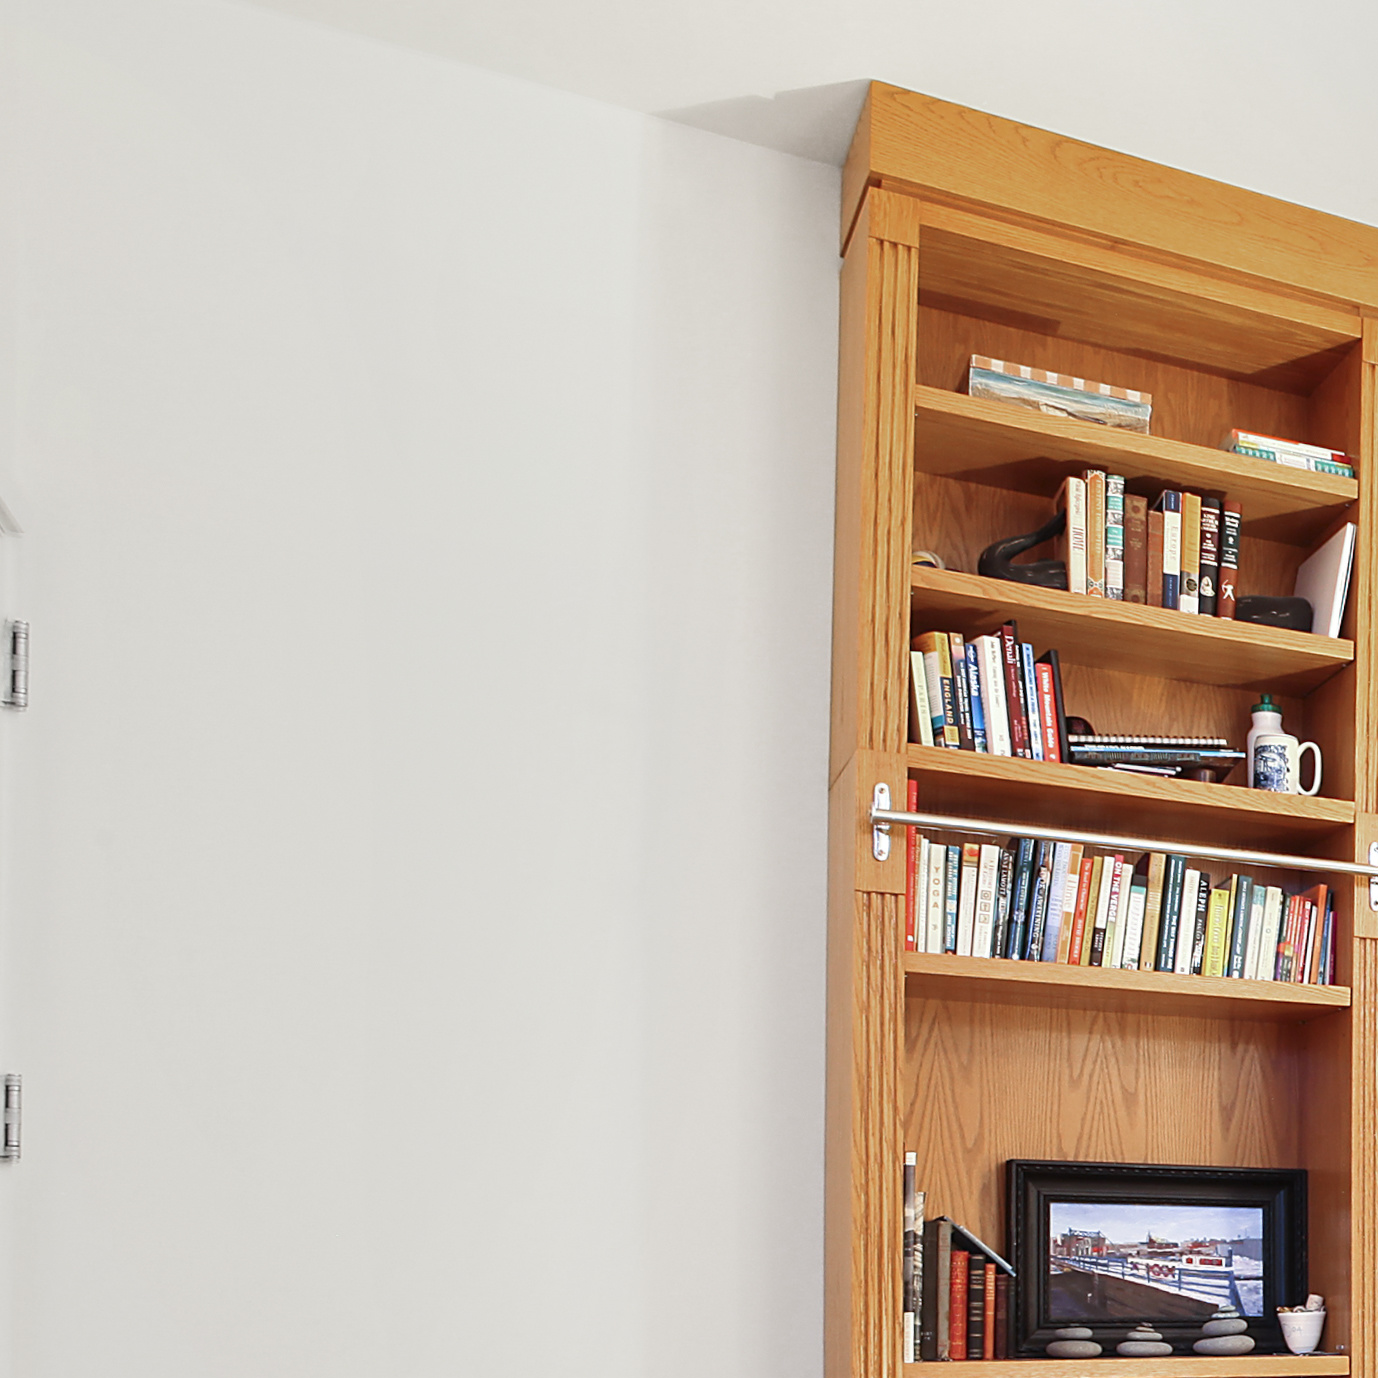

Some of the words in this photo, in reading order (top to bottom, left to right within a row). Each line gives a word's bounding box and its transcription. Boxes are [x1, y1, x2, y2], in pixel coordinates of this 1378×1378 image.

[1005, 635, 1015, 663] Denali
[969, 664, 979, 696] Alaska
[1042, 672, 1050, 692] White
[943, 680, 953, 724] ENGLAND
[1044, 694, 1052, 726] Mountain
[1047, 728, 1055, 748] Guide
[1115, 862, 1122, 874] ON
[1112, 877, 1120, 892] THE
[1198, 880, 1207, 911] ALEPH
[1109, 894, 1118, 922] VERGE
